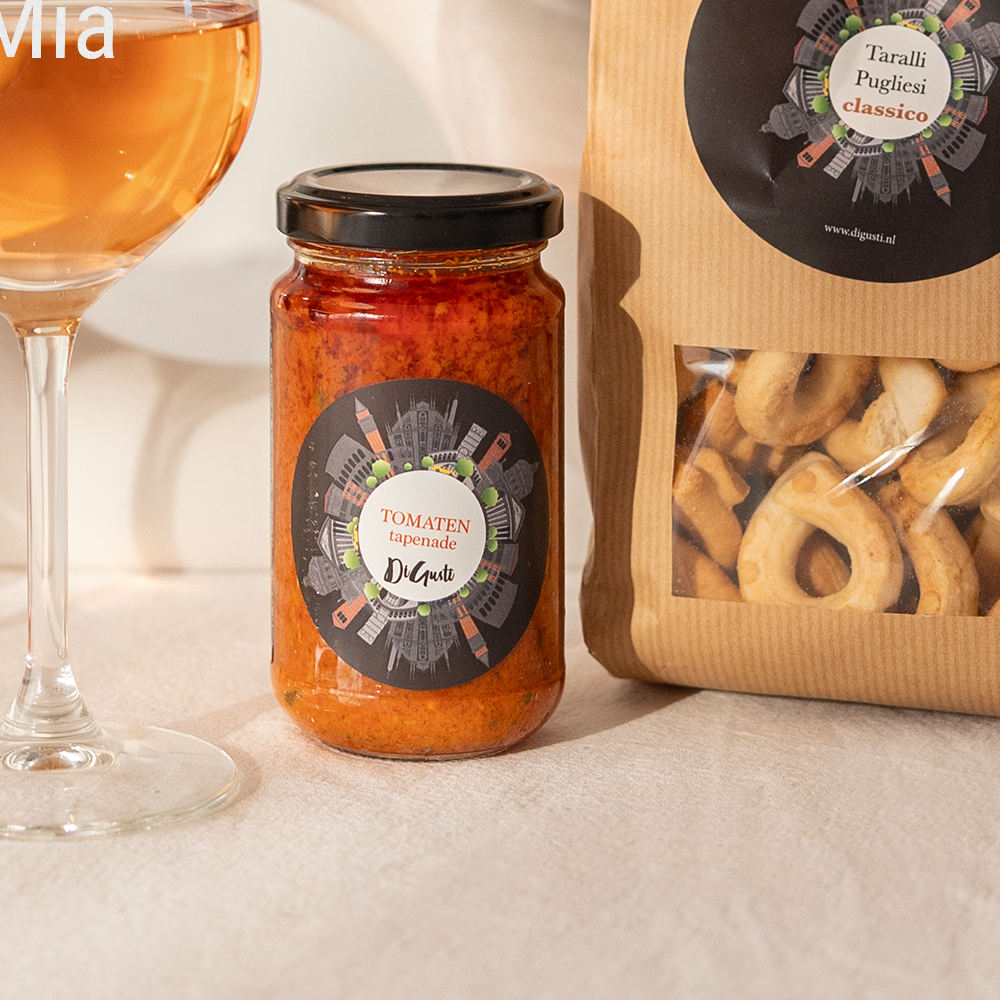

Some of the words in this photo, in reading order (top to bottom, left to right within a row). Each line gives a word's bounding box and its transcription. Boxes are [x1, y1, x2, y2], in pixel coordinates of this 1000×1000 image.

[866, 44, 926, 68] Taralli
[854, 69, 926, 95] Pugliesi
[842, 97, 928, 122] classico
[824, 224, 896, 244] www.digusti.nl
[381, 508, 471, 533] TOMATEN
[389, 530, 457, 550] tapenade
